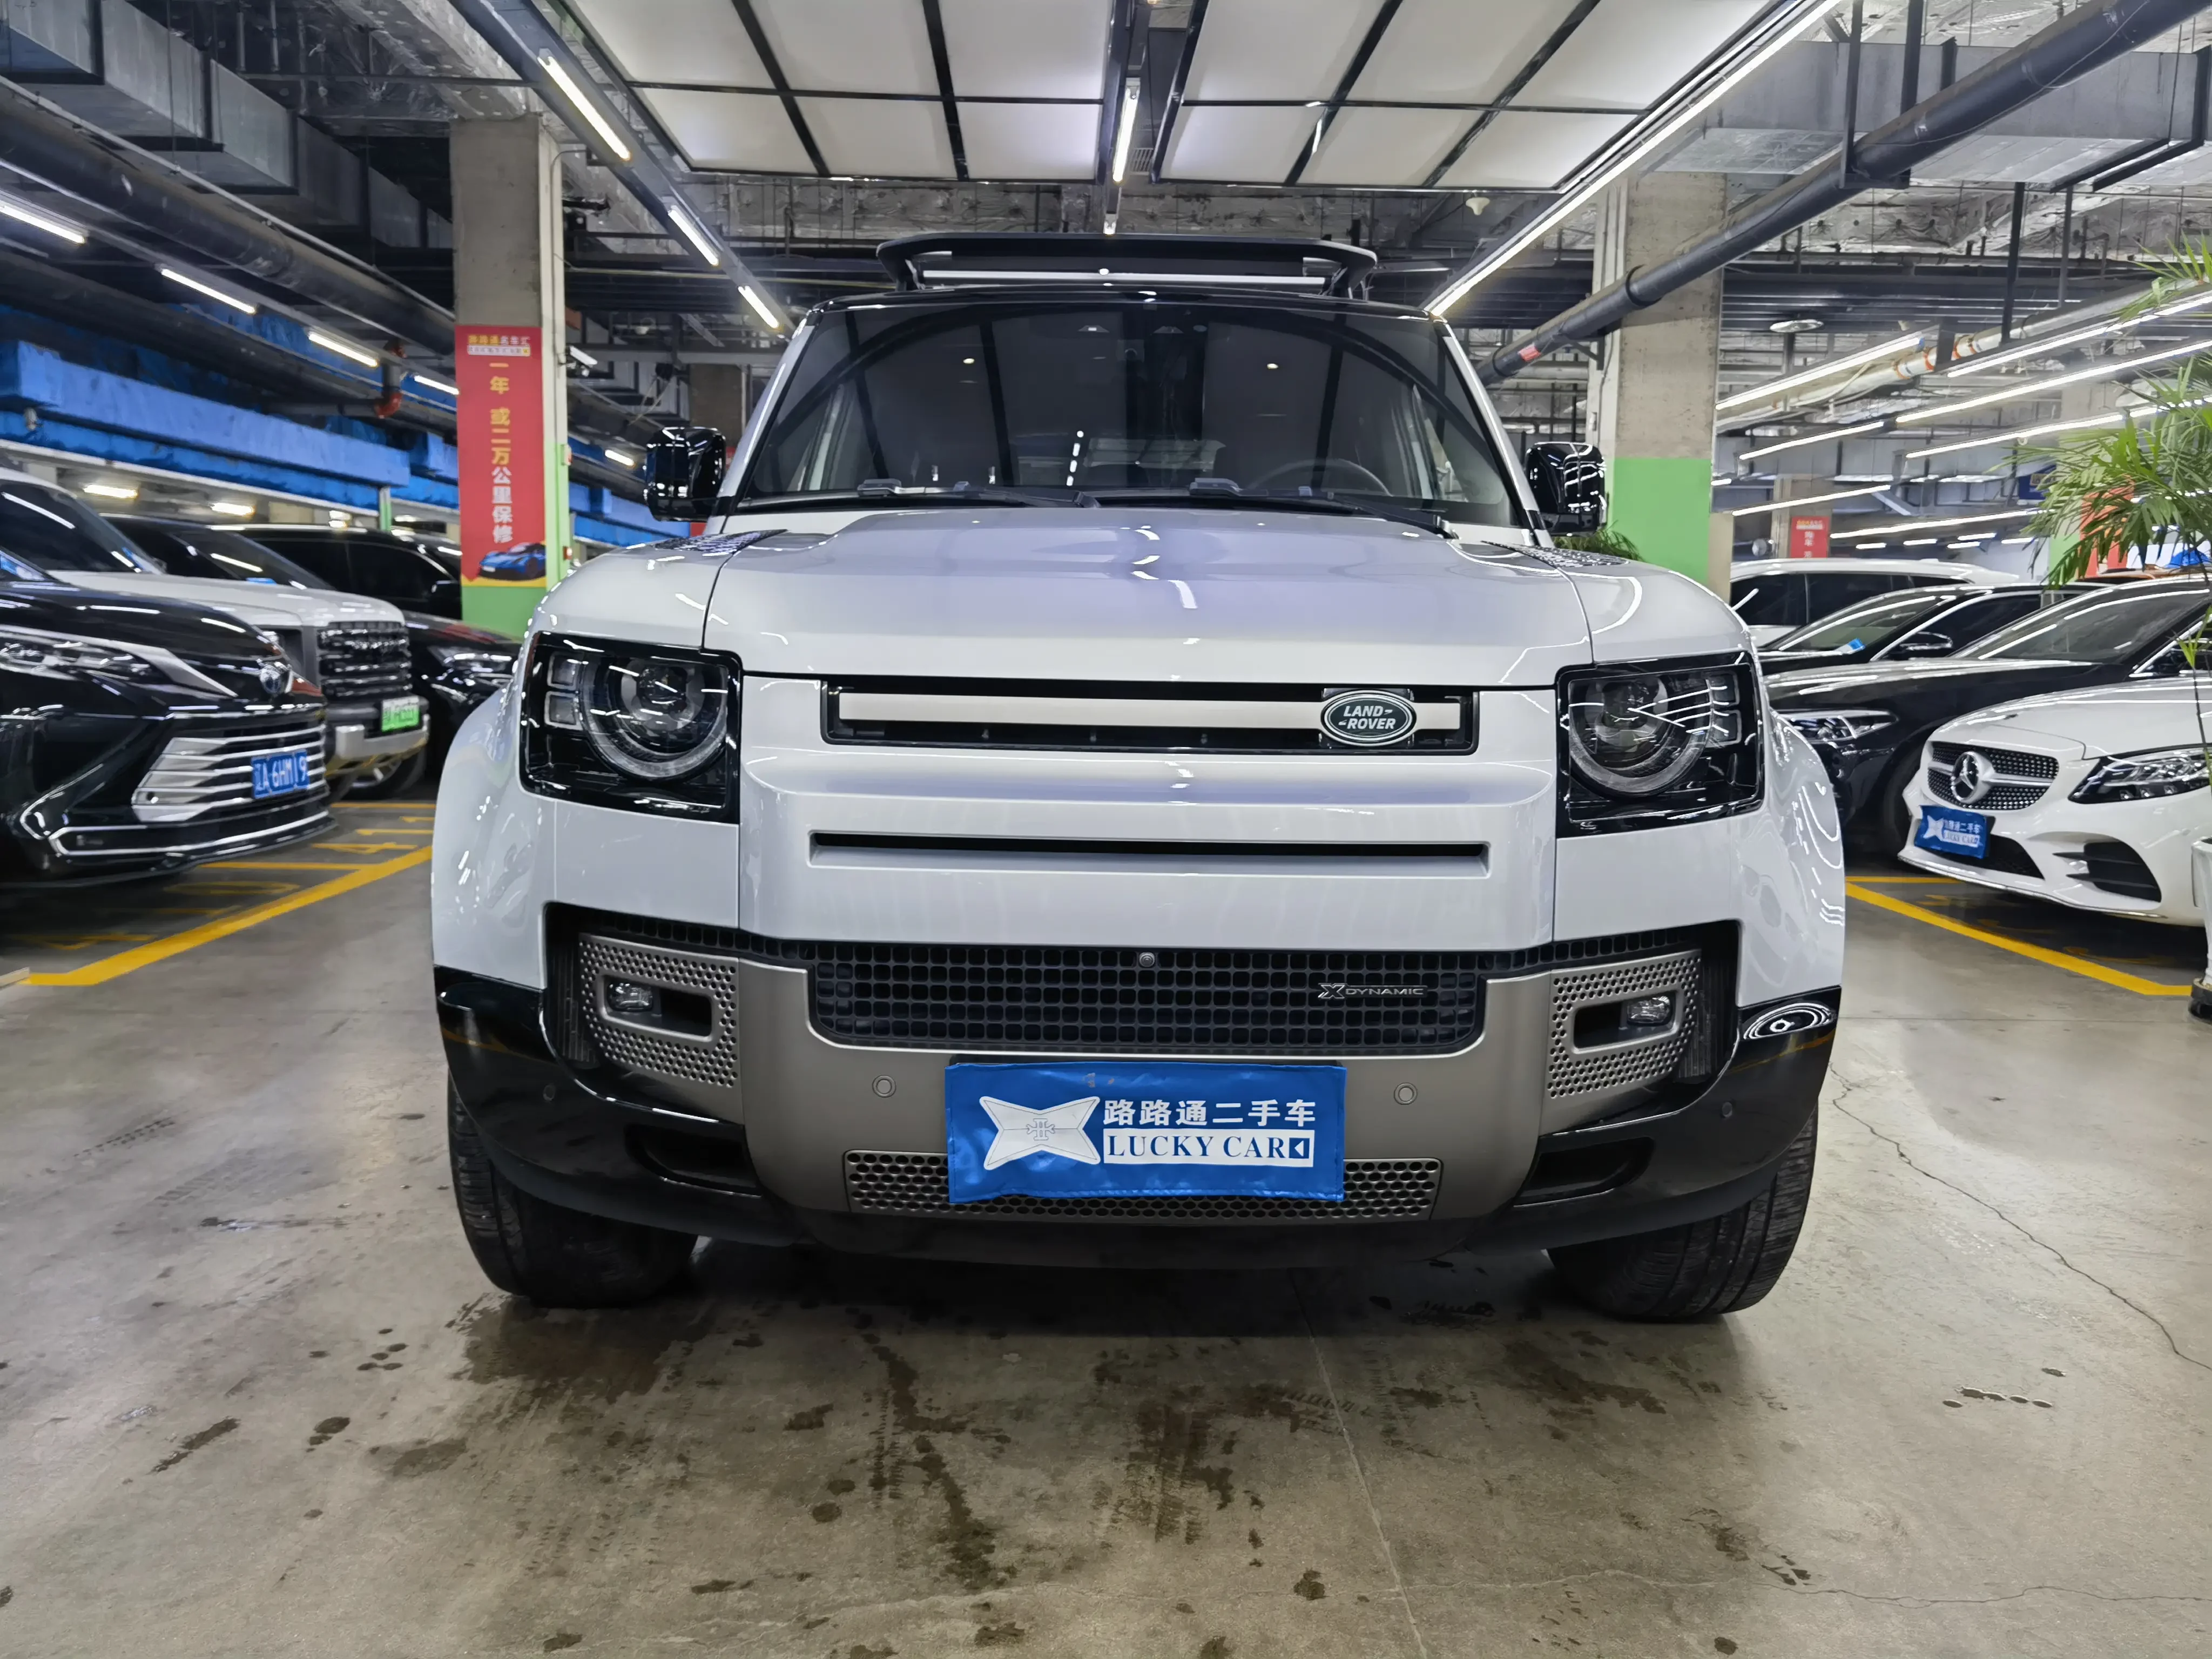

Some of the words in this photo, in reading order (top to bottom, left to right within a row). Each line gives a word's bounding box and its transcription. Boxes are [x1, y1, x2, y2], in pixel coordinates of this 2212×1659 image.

[489, 362, 510, 394] 一年
[1343, 705, 1384, 717] LAND
[1347, 718, 1397, 730] ROVER
[1103, 1099, 1316, 1127] 路路通二手车
[1108, 1135, 1214, 1157] LUCKY
[1223, 1136, 1289, 1158] CAR
